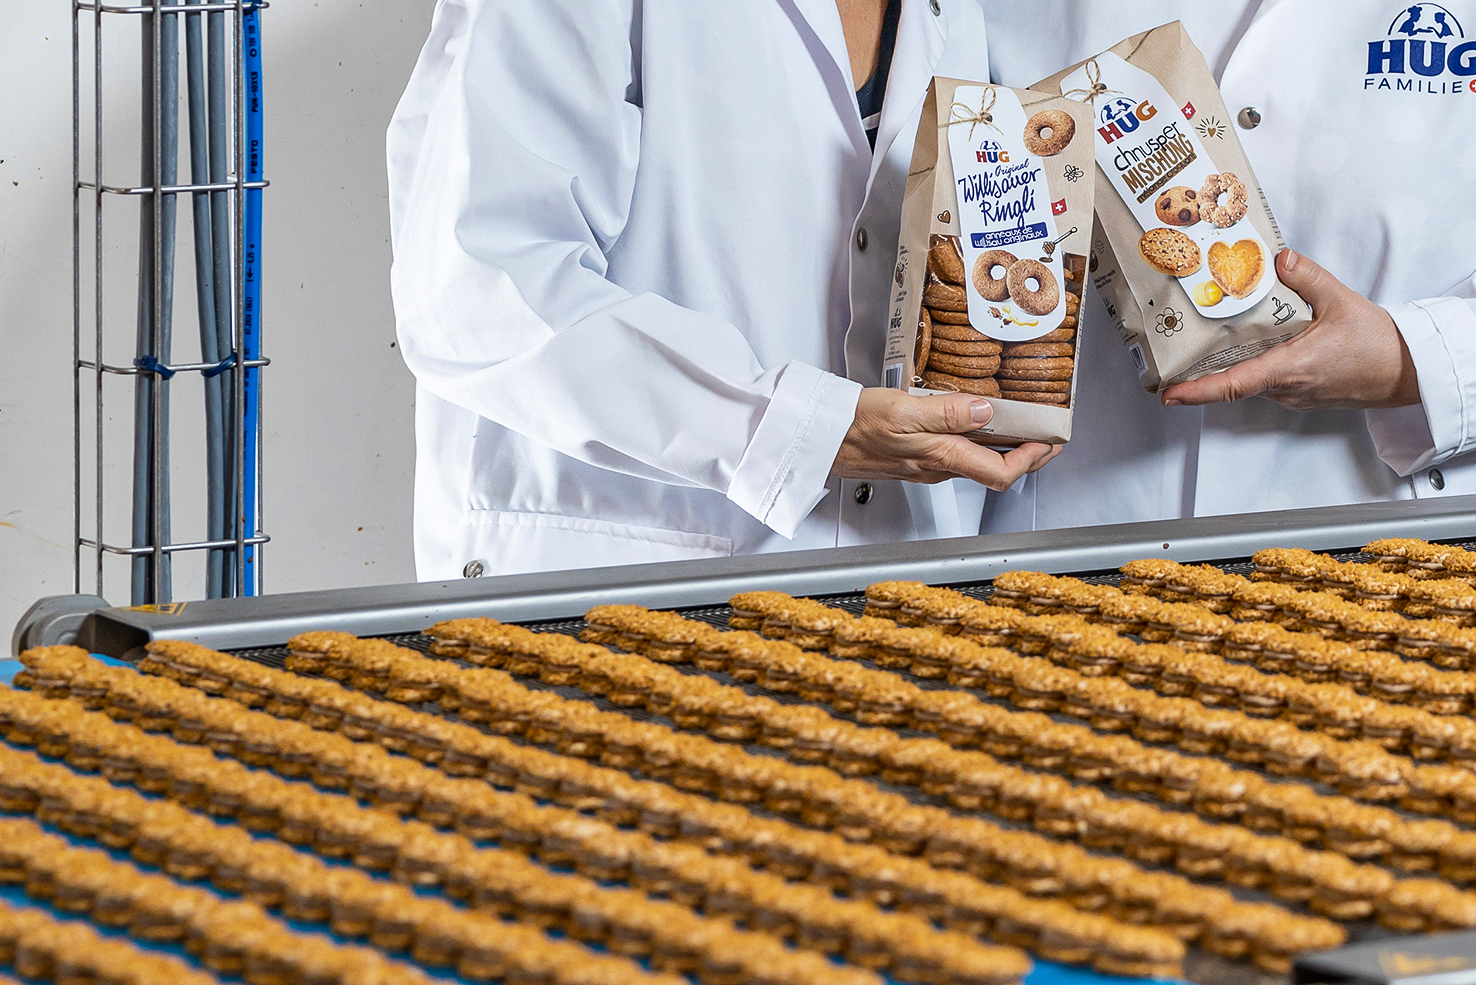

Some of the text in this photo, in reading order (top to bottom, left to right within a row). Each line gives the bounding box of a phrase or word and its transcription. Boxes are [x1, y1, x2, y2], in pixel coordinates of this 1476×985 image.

[1363, 78, 1463, 94] FAMILIE
[1096, 99, 1158, 145] HUG
[250, 140, 259, 174] FESTO
[976, 151, 1010, 163] HUG
[1114, 121, 1181, 171] chnusper
[994, 158, 1029, 177] Original
[1121, 133, 1194, 195] MISCHUNG
[958, 168, 1041, 203] Willisauer
[1138, 175, 1168, 202] mélange
[979, 185, 1035, 228] Ringli
[985, 226, 1033, 239] anneaux de
[1004, 230, 1043, 243] originaux
